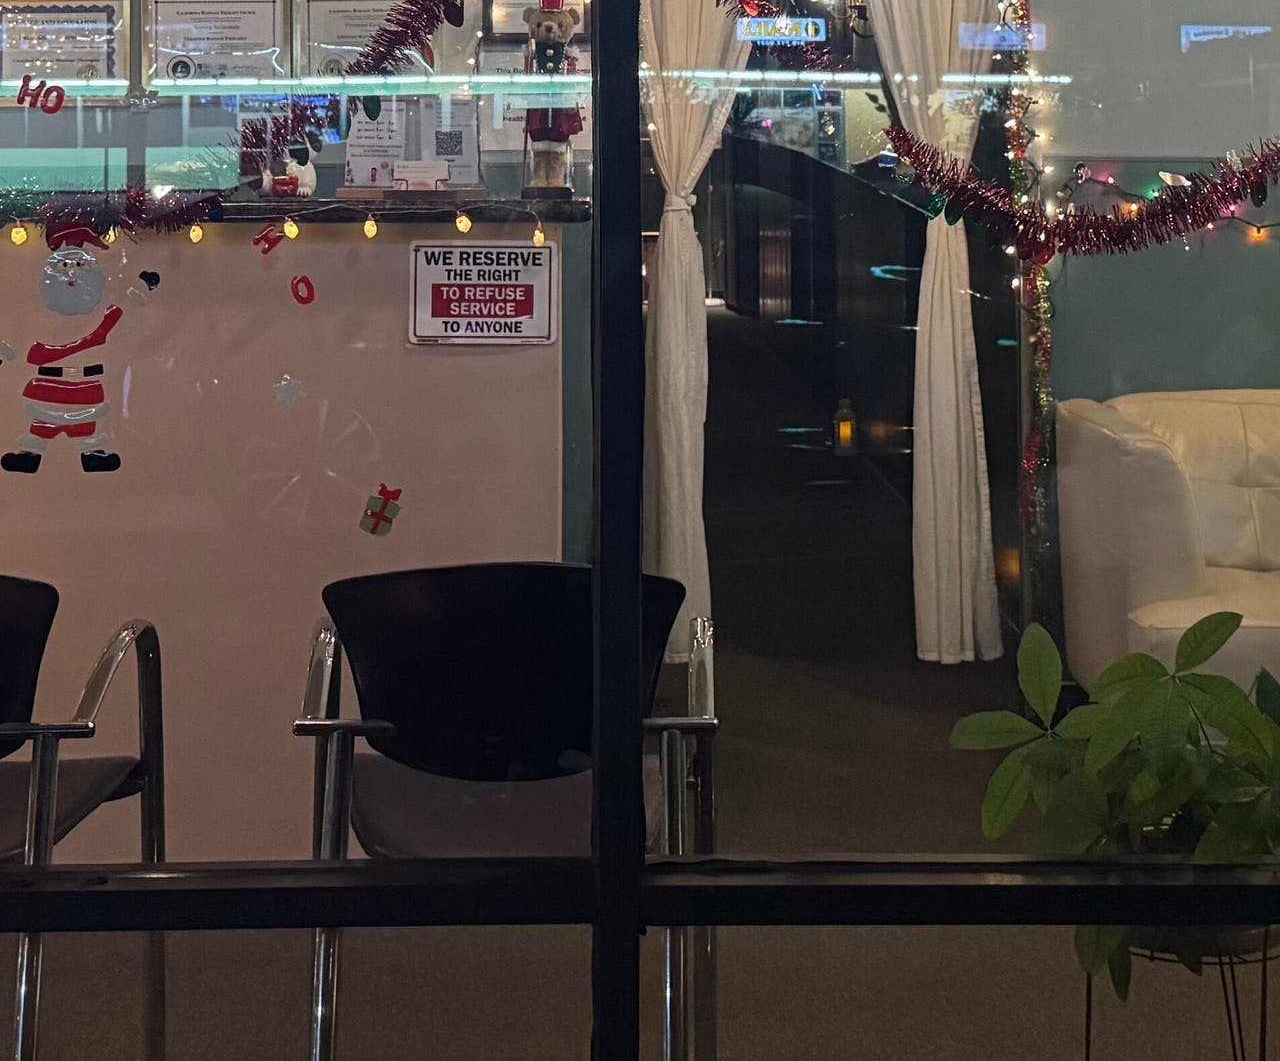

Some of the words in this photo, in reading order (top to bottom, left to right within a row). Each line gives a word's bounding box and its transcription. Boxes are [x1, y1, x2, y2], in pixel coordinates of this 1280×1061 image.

[16, 74, 66, 115] HO
[424, 251, 453, 266] WE
[459, 251, 543, 267] RESERVE
[445, 269, 473, 281] THE
[477, 269, 521, 282] RIGHT
[441, 287, 459, 299] TO
[465, 287, 526, 300] REFUSE
[450, 302, 516, 315] SERVICE
[442, 321, 460, 333] TO
[464, 321, 523, 333] ANYONE
